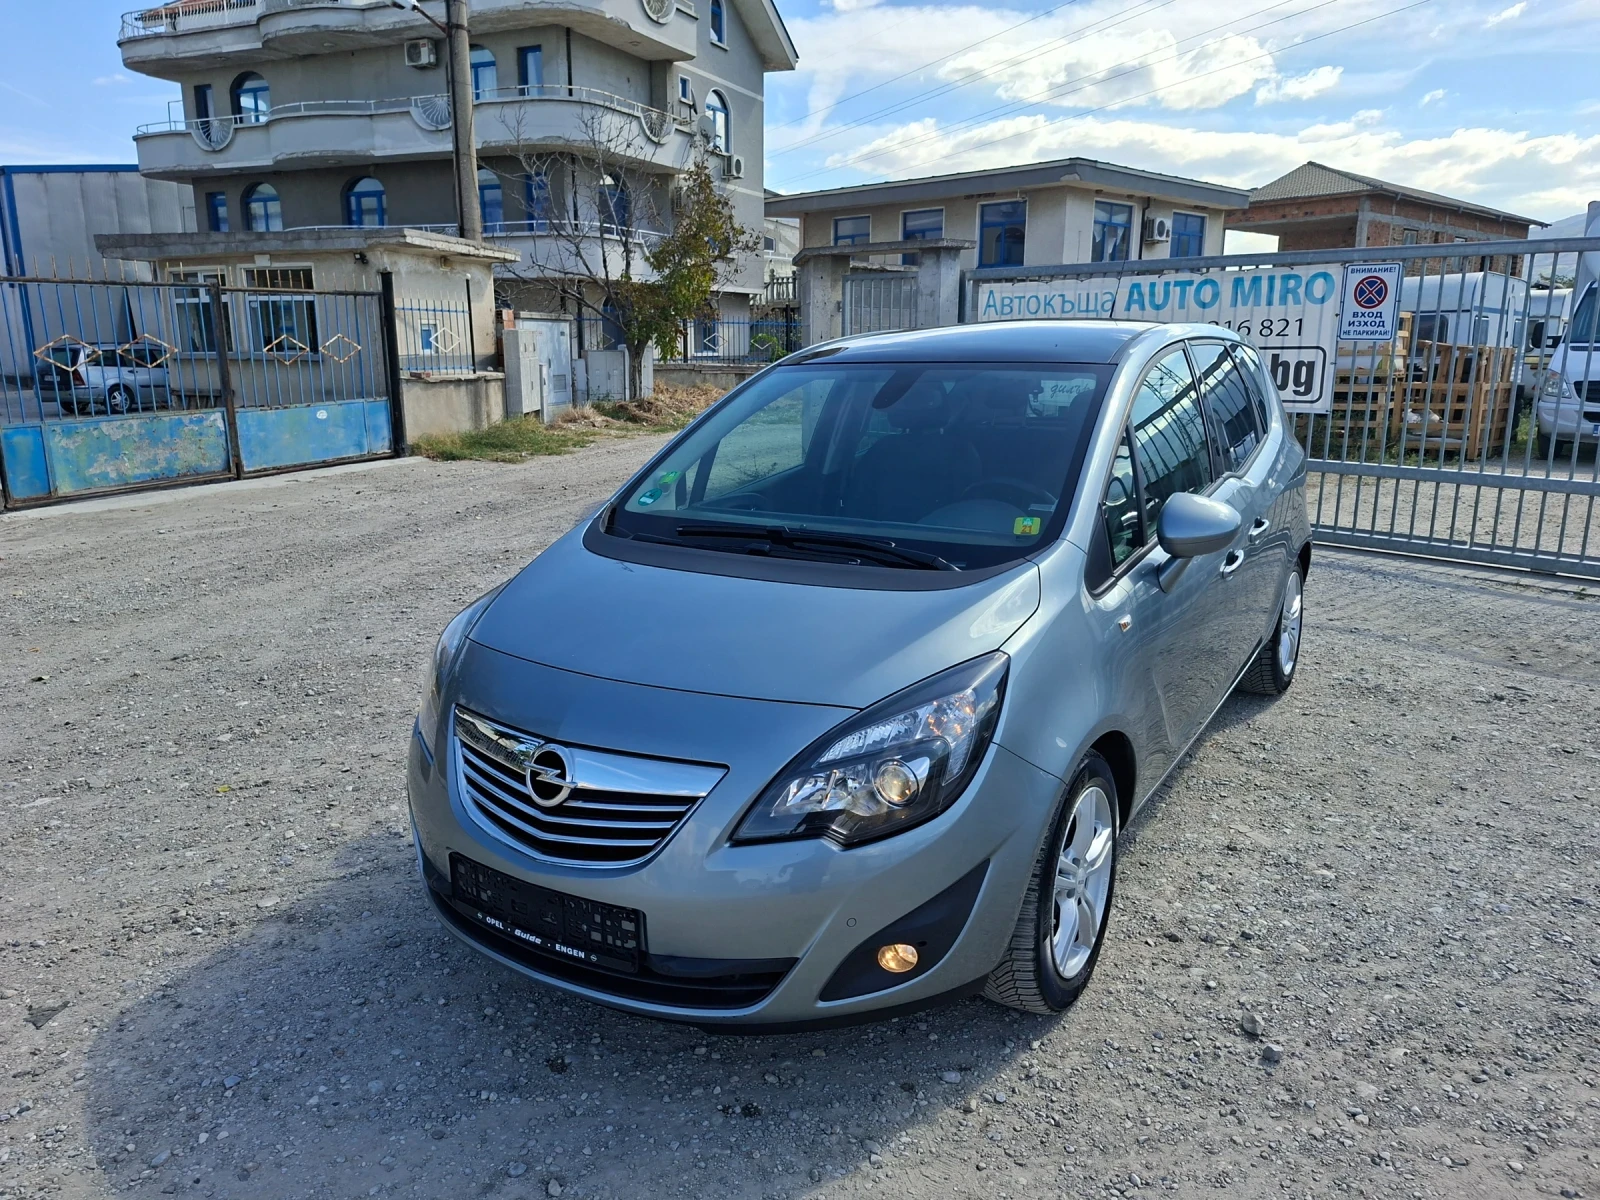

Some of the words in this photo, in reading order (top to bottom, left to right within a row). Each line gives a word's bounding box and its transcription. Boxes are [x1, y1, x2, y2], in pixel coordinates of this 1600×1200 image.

[1124, 278, 1220, 312] AUTO
[1230, 271, 1335, 308] MIRO
[1348, 320, 1386, 328] ИЗХОД
[1352, 311, 1383, 319] ВХОД
[1259, 318, 1303, 337] 821
[486, 916, 505, 931] OPEL
[514, 928, 542, 945] Guide
[555, 943, 585, 959] ENGEN
